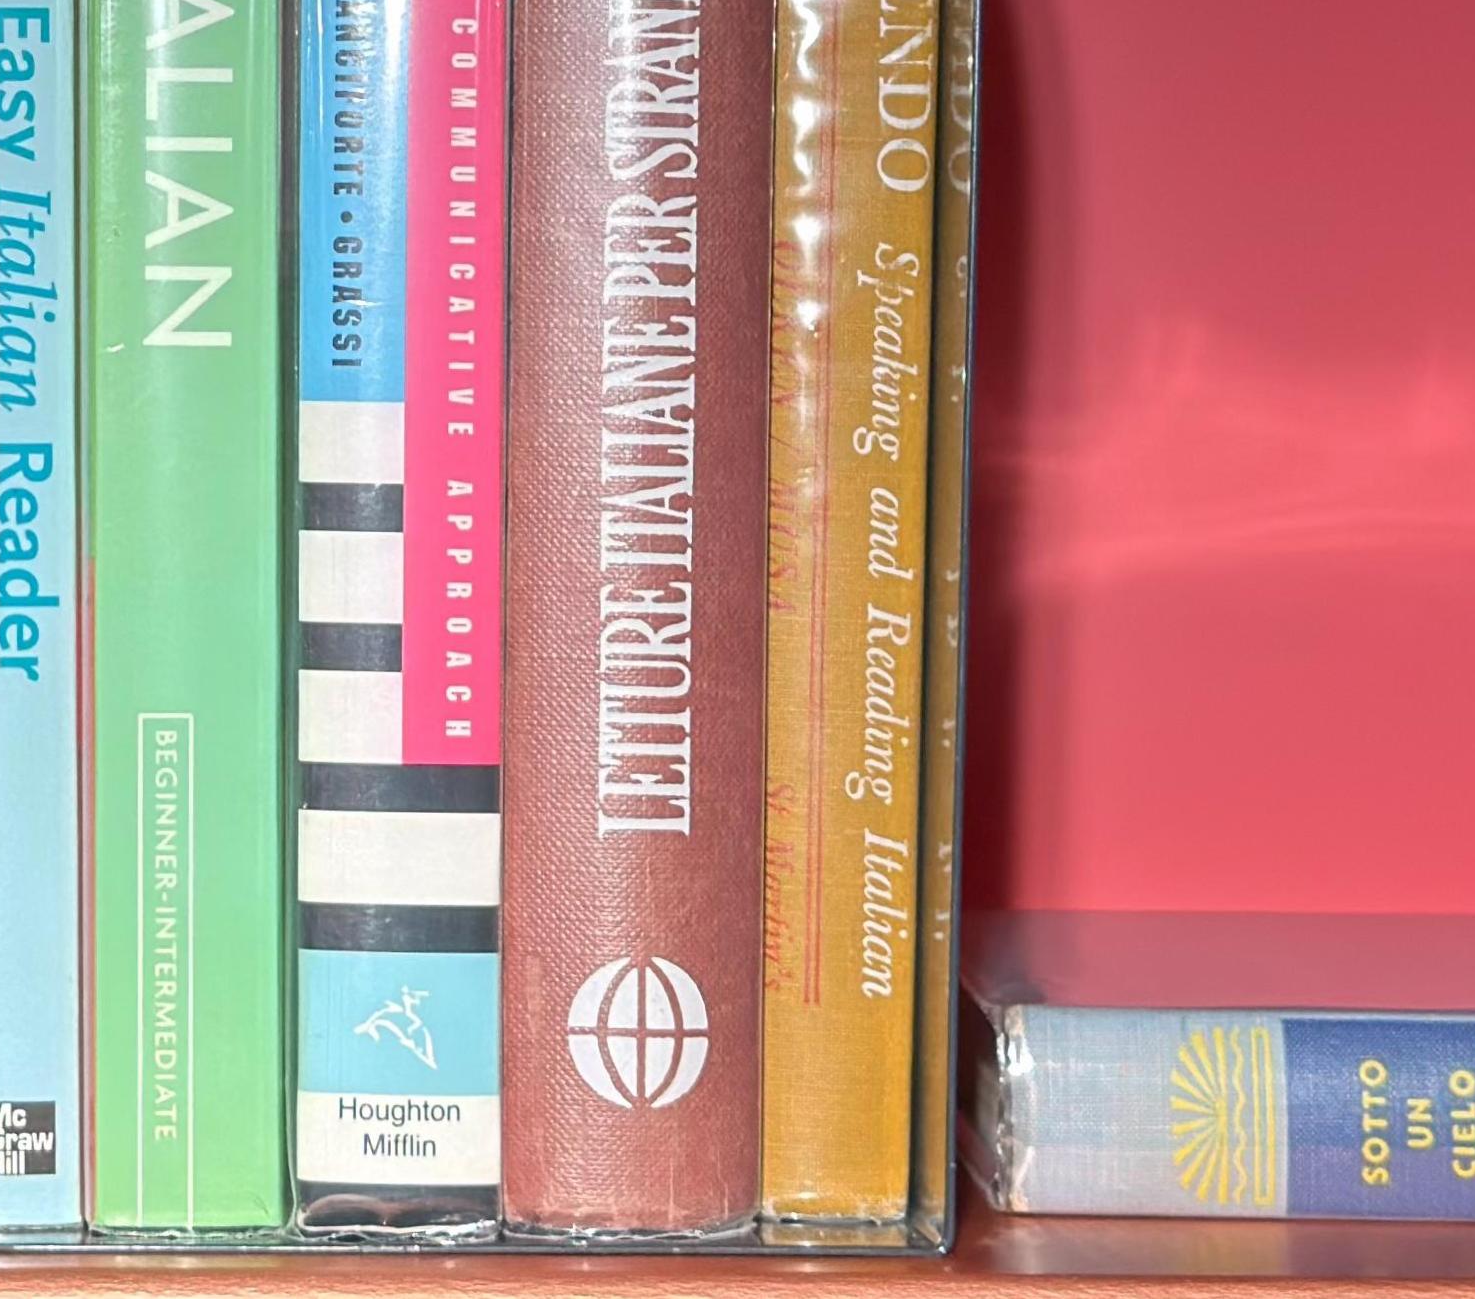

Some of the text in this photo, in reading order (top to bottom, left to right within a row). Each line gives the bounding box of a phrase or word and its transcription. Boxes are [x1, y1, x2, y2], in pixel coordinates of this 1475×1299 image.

[332, 235, 364, 368] GRASSI
[448, 18, 478, 435] COMMUNICATIVE
[602, 193, 699, 305] PER
[600, 308, 697, 573] ITALIANE
[445, 479, 474, 737] APPROACH
[845, 242, 921, 999] Speaking and Reading Italian
[598, 582, 693, 841] LETTURE
[154, 728, 179, 1141] BEGINNER-INTERMEDIATE
[338, 1097, 461, 1127] Houghton
[363, 1133, 437, 1157] Mifflin
[1359, 1059, 1390, 1186] SOTTO
[1407, 1097, 1435, 1149] UN
